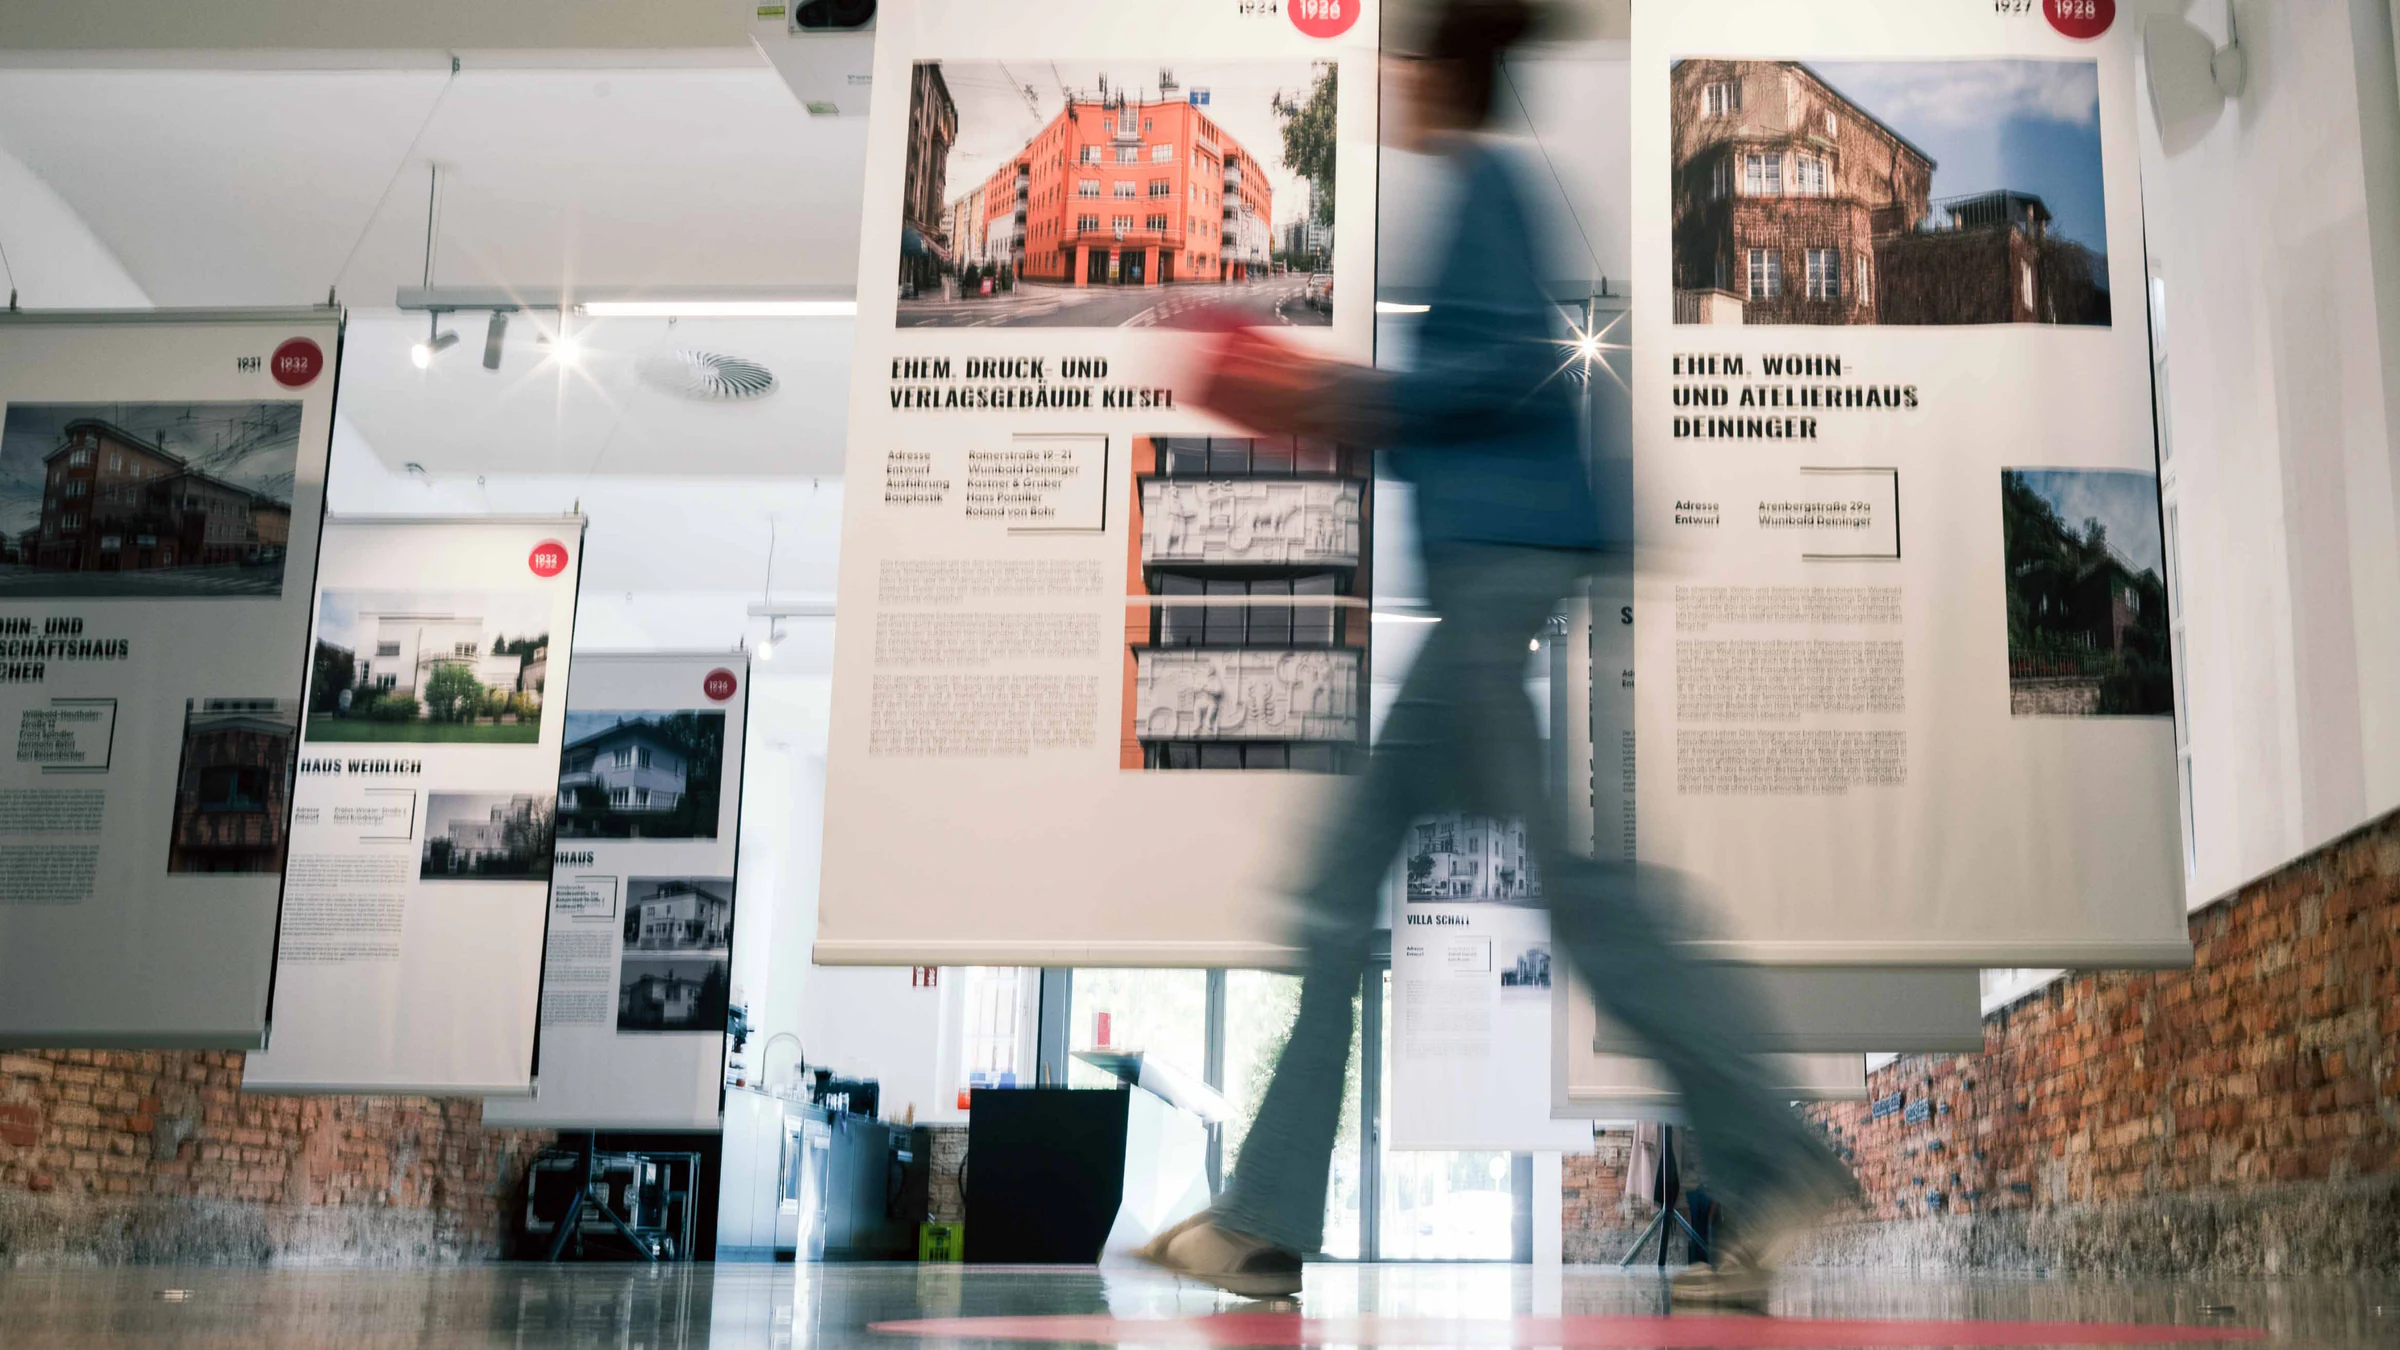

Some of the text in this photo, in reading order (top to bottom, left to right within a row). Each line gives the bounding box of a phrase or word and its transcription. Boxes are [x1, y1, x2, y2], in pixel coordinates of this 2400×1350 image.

[2054, 0, 2095, 19] 1928
[237, 356, 309, 373] 1931 1932
[891, 357, 1108, 380] EHEM. DRUCK- UND
[1673, 354, 1853, 378] EHEM. WOHN-
[890, 381, 1094, 411] VERLAGSGEBÄUDE
[1673, 385, 1919, 410] UND ATELIERHAUS
[1673, 416, 1818, 441] DEININGER
[887, 449, 931, 461] Adresse
[886, 464, 932, 476] Entwurf
[968, 463, 1024, 476] Wunibald
[966, 492, 994, 505] Hans
[1675, 501, 1719, 512] Adresse
[1675, 514, 1720, 527] Entwurf
[535, 554, 557, 568] 1932
[44, 617, 84, 638] UND
[301, 759, 422, 777] HAUS WEIDLICH
[1407, 914, 1433, 926] VILLA
